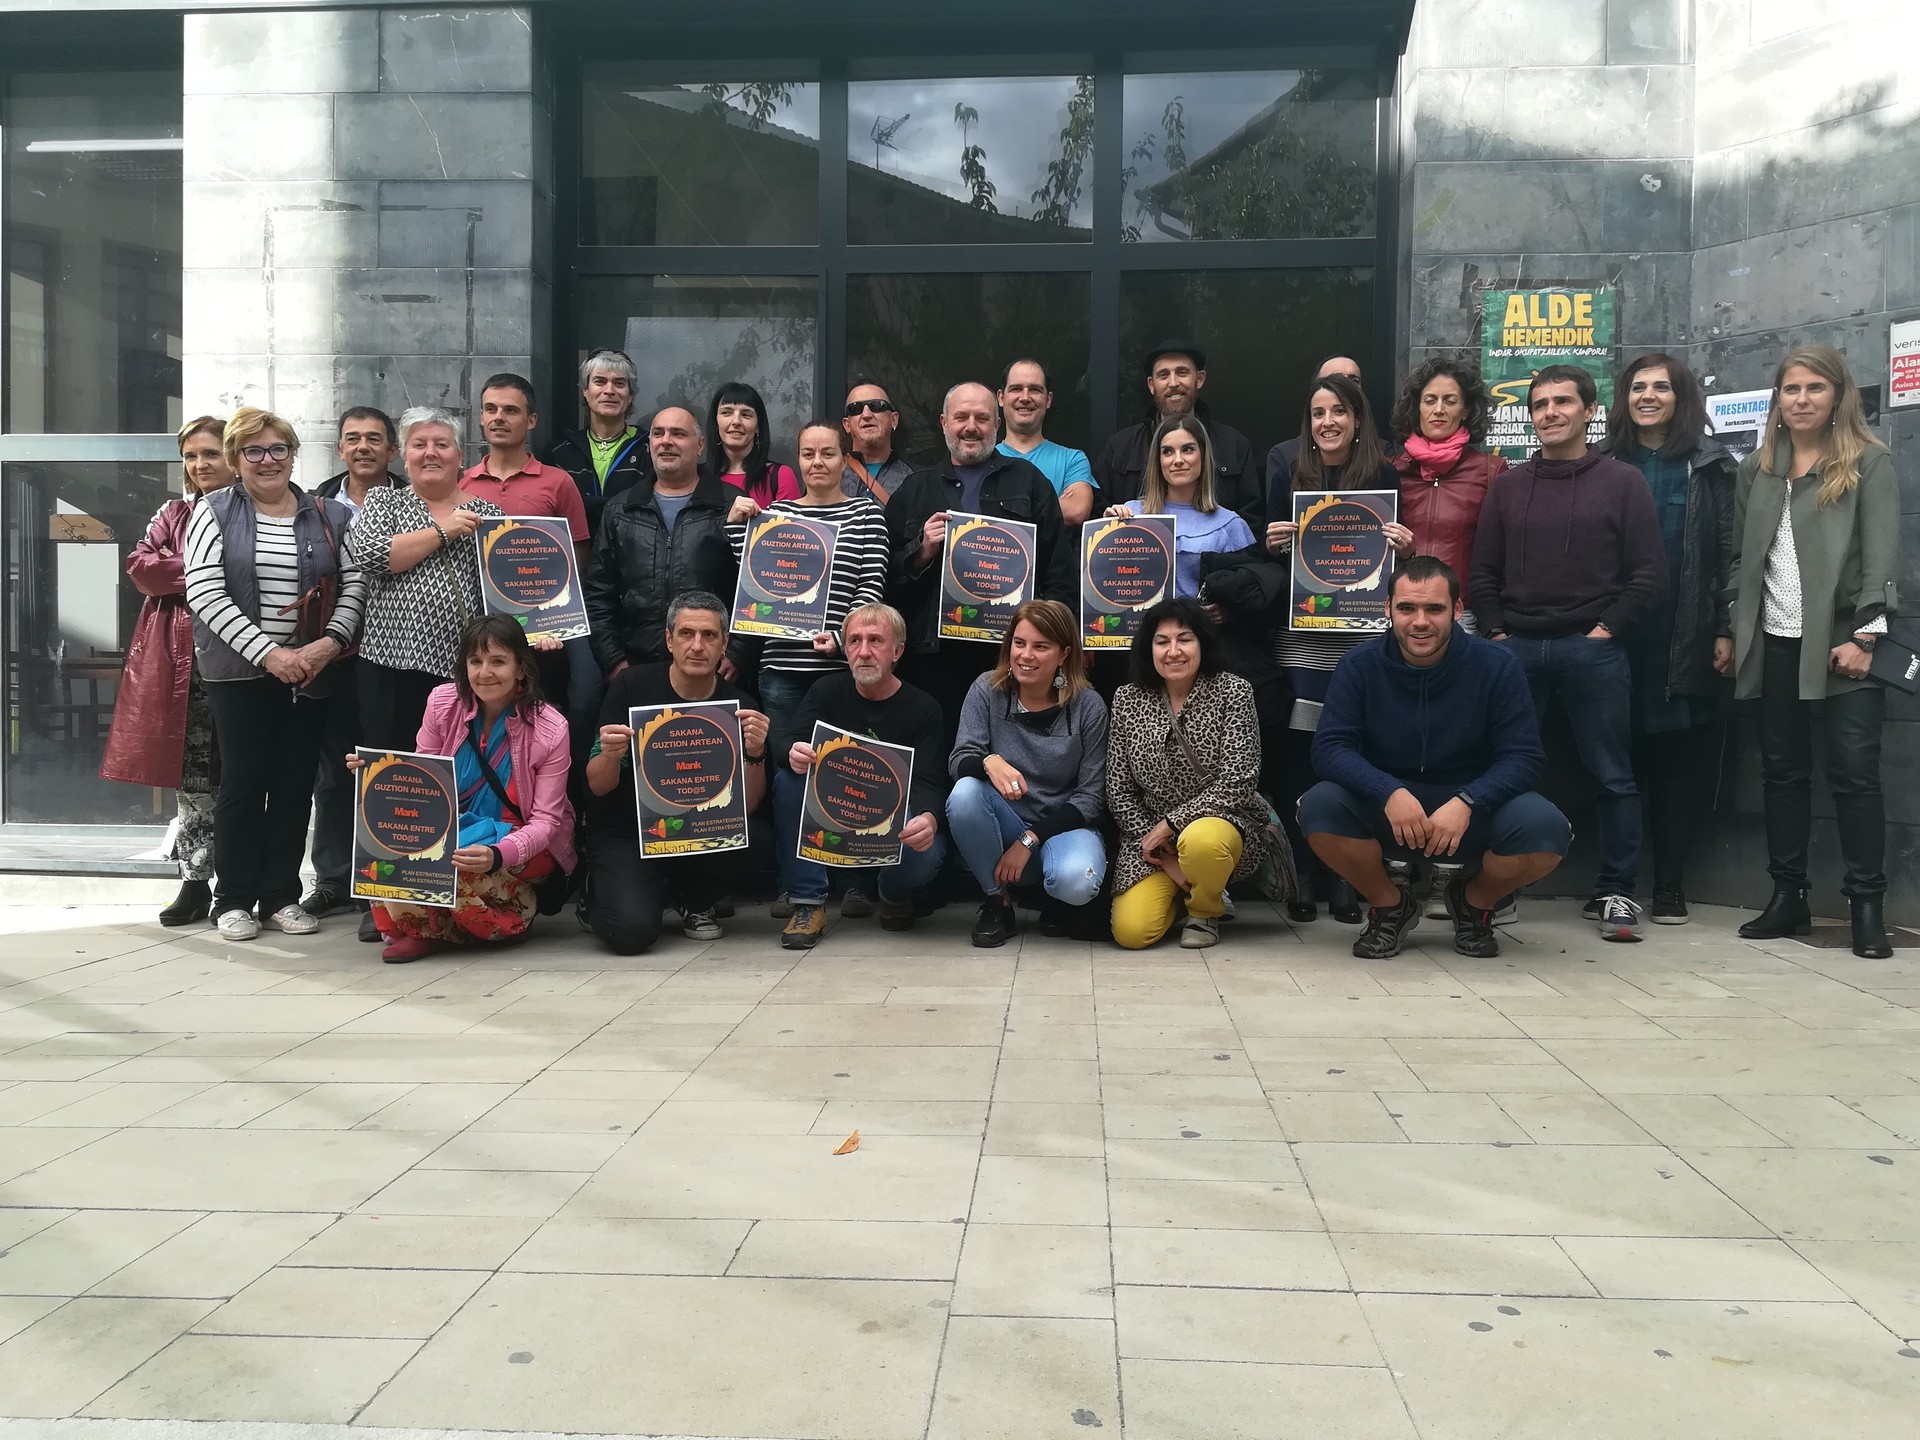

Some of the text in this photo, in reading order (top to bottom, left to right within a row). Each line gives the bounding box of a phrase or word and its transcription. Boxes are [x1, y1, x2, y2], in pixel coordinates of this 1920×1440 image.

[1504, 293, 1593, 328] ALDE
[1502, 328, 1595, 347] HEMENDIK
[1489, 348, 1608, 357] INDAR OKUPATZAILEAK KANPORA!
[1895, 382, 1914, 390] Aviso
[1715, 400, 1770, 416] PRESENTACI
[762, 540, 791, 548] GUZTION
[977, 535, 1005, 544] SAKANA
[961, 541, 991, 551] GUZTION
[992, 545, 1020, 555] ARTEAN
[1331, 544, 1355, 553] Mank
[777, 560, 798, 568] Mank
[979, 560, 1000, 570] Mank
[517, 566, 541, 575] Mank
[761, 571, 788, 579] SAKANA
[1117, 566, 1140, 574] Mank
[963, 572, 1014, 583] SAKANA ENTRE
[773, 581, 797, 589] TOD@S
[976, 582, 1000, 590] TOD@S
[1905, 657, 1920, 680] emun
[669, 728, 704, 737] SAKANA
[652, 738, 723, 749] GUZTION ARTEAN
[676, 761, 702, 771] Mank
[843, 756, 875, 771] SAKANA
[827, 760, 859, 776] GUZTION
[860, 771, 892, 784] ARTEAN
[392, 774, 423, 784] SAKANA
[660, 775, 720, 786] SAKANA ENTRE
[374, 784, 441, 797] GUZTION ARTEAN
[677, 787, 706, 795] TOD@S
[844, 785, 868, 800] Mank
[827, 795, 883, 814] SAKANA ENTRE
[394, 807, 419, 818] Mank
[840, 809, 866, 821] TOD@S
[377, 821, 435, 834] SAKANA ENTRE
[392, 834, 420, 843] TOD@S
